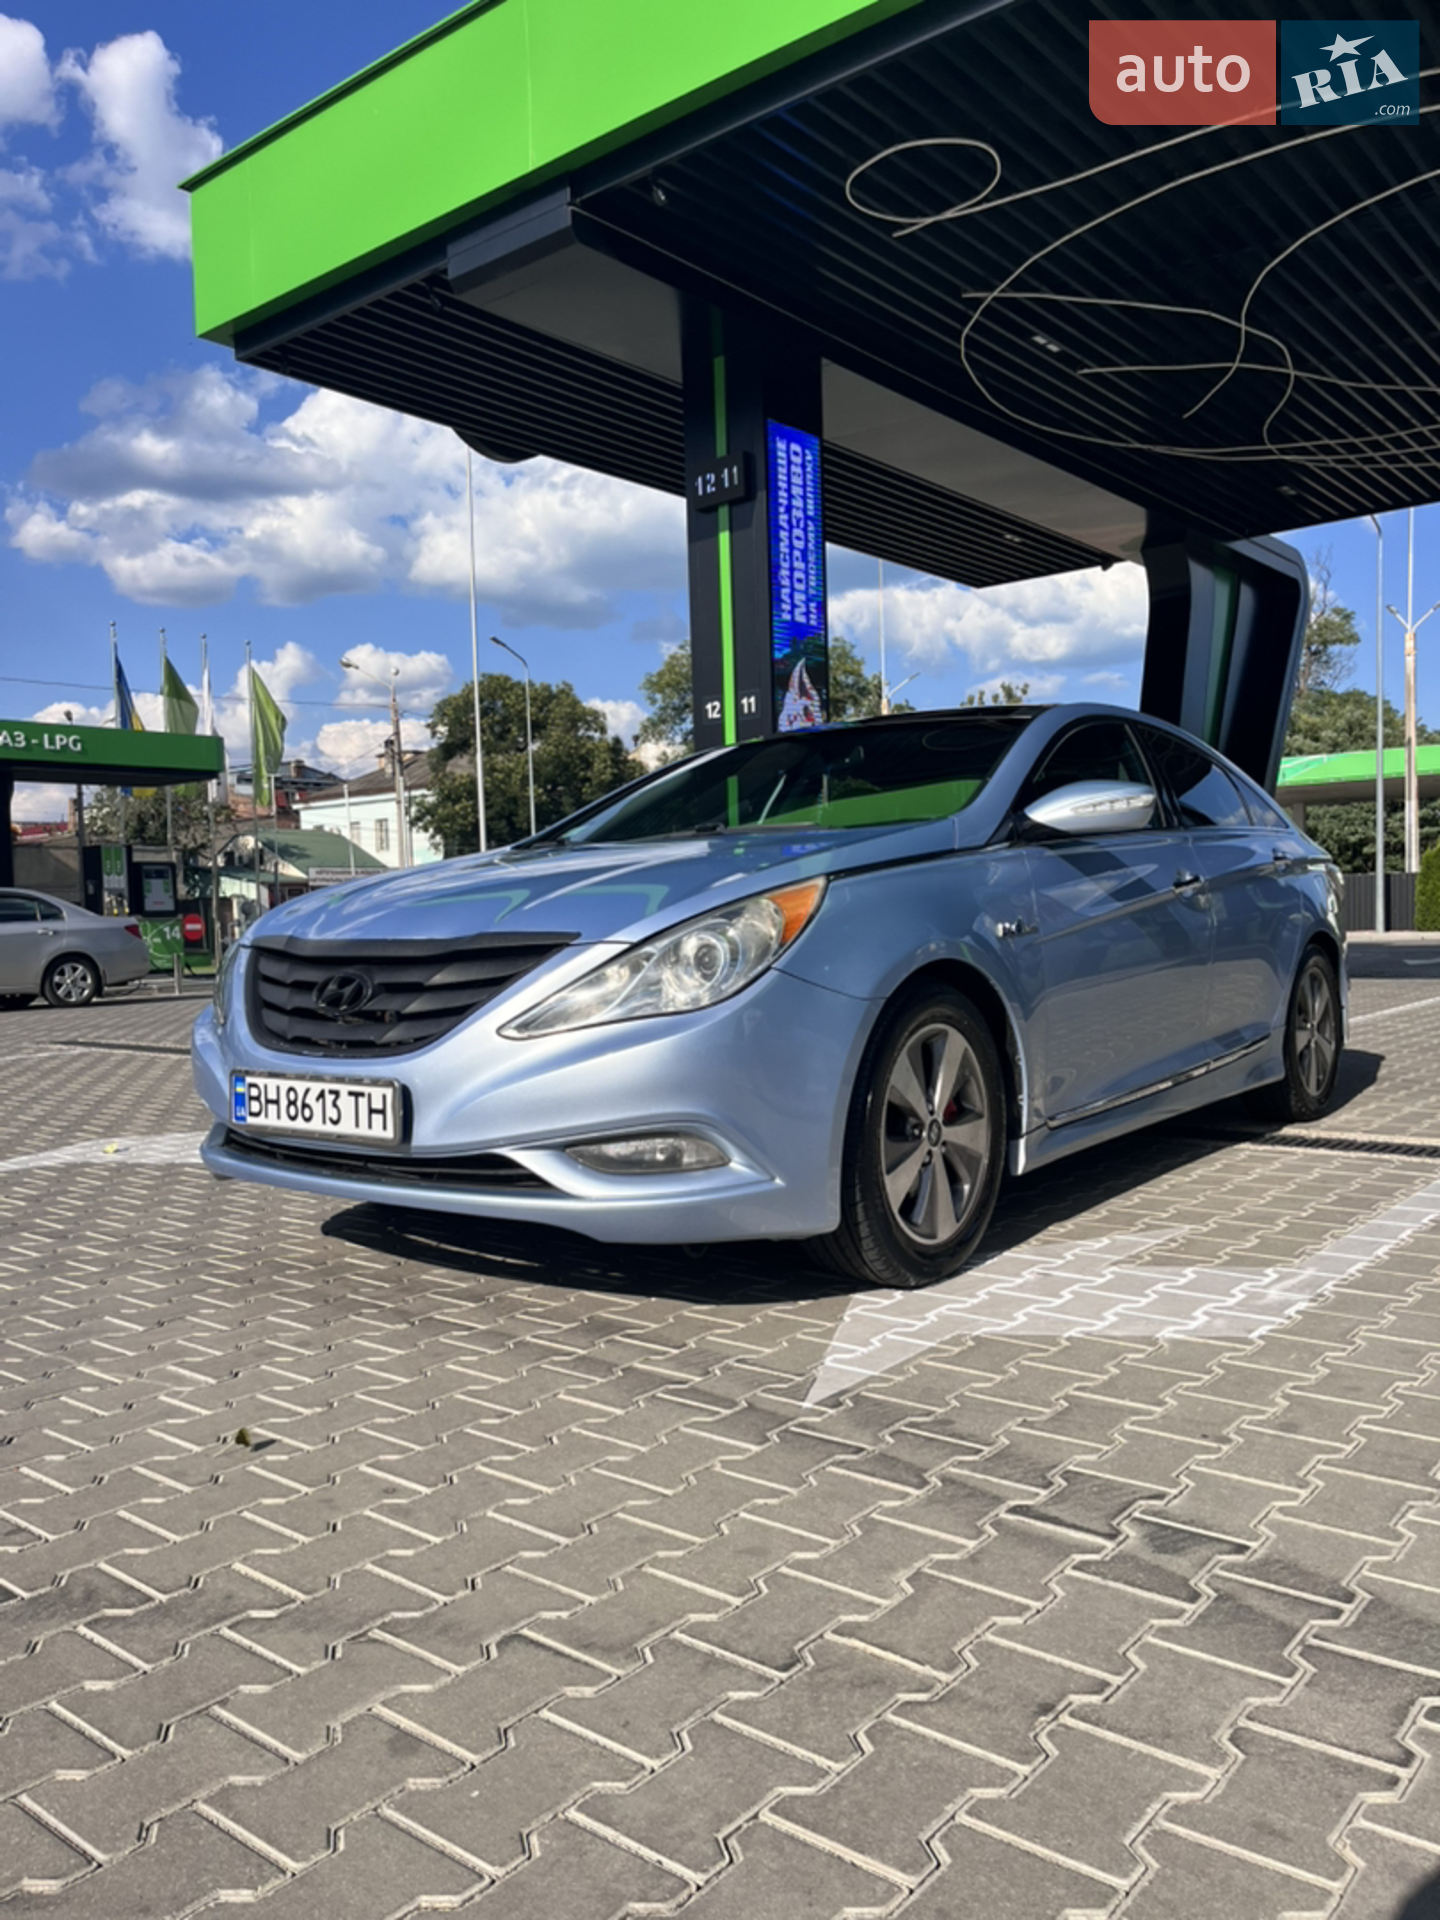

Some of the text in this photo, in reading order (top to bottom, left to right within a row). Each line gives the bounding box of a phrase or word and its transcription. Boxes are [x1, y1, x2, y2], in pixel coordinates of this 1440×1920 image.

[694, 465, 739, 497] 12 11
[776, 436, 792, 621] НАЙСМАЧНІШЕ
[790, 442, 807, 623] МОРОЗИВО
[705, 695, 757, 719] 12 11
[43, 733, 82, 752] LPG
[163, 925, 181, 940] 14
[248, 1083, 387, 1131] BH 8613 TH
